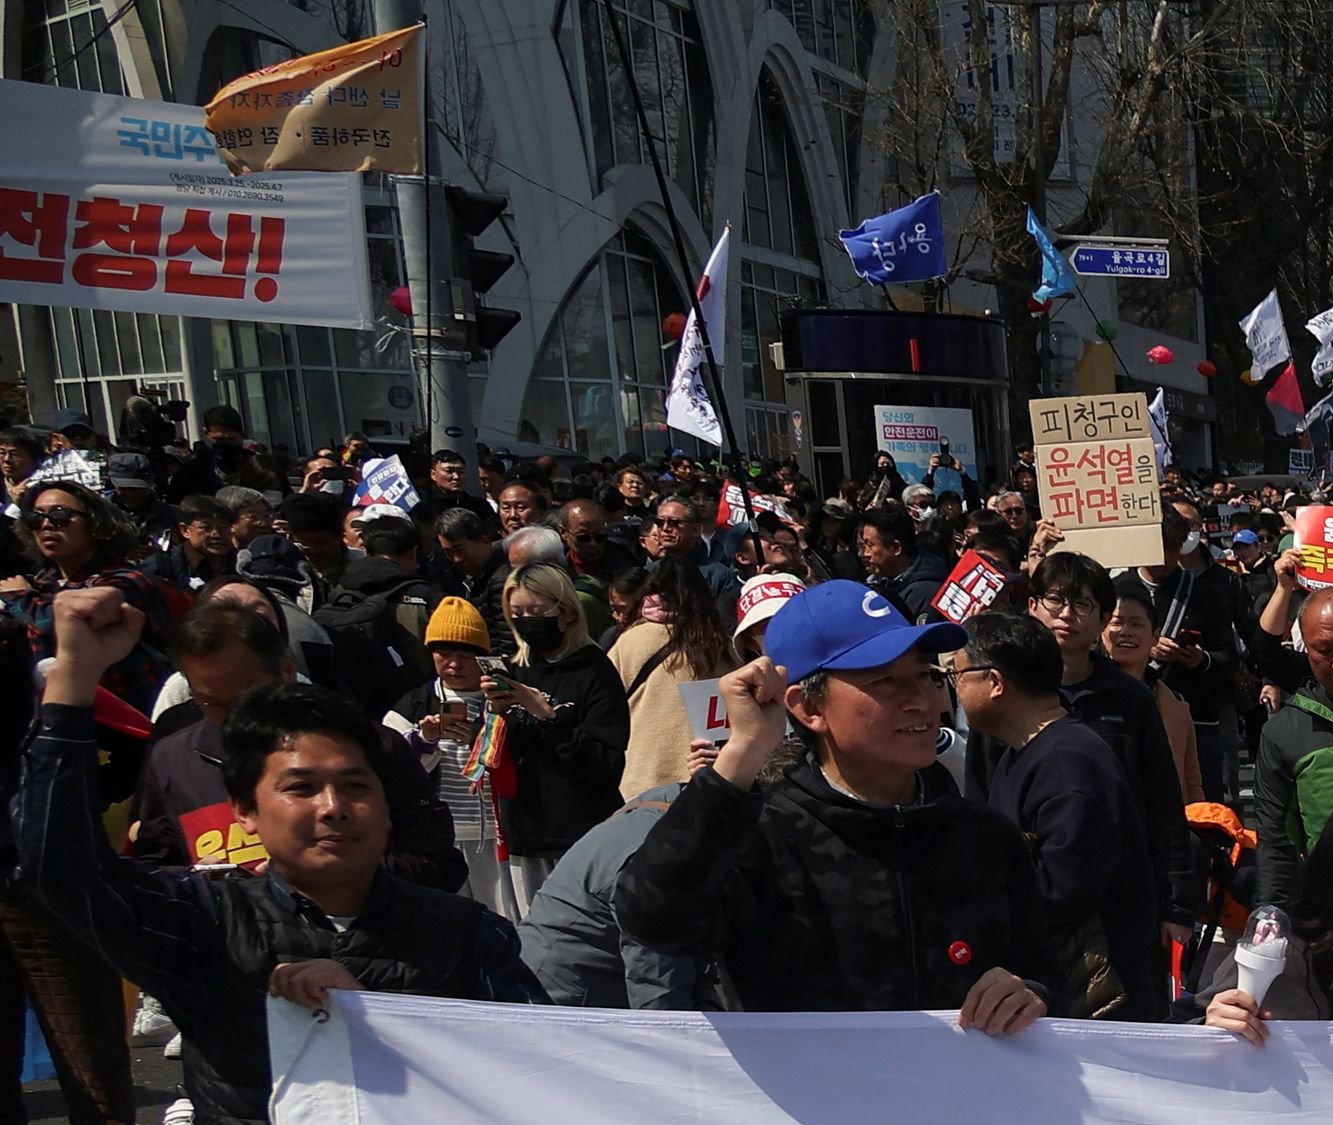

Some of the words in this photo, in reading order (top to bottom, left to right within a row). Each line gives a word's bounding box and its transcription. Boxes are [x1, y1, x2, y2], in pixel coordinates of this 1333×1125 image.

[1105, 264, 1146, 275] Yulgok-ro
[1111, 251, 1165, 266] 율곡로4길
[884, 425, 937, 439] 안전운전이
[1040, 400, 1144, 440] 피청구인
[1045, 443, 1154, 488] 윤석열을
[1049, 486, 1158, 525] 파면한다
